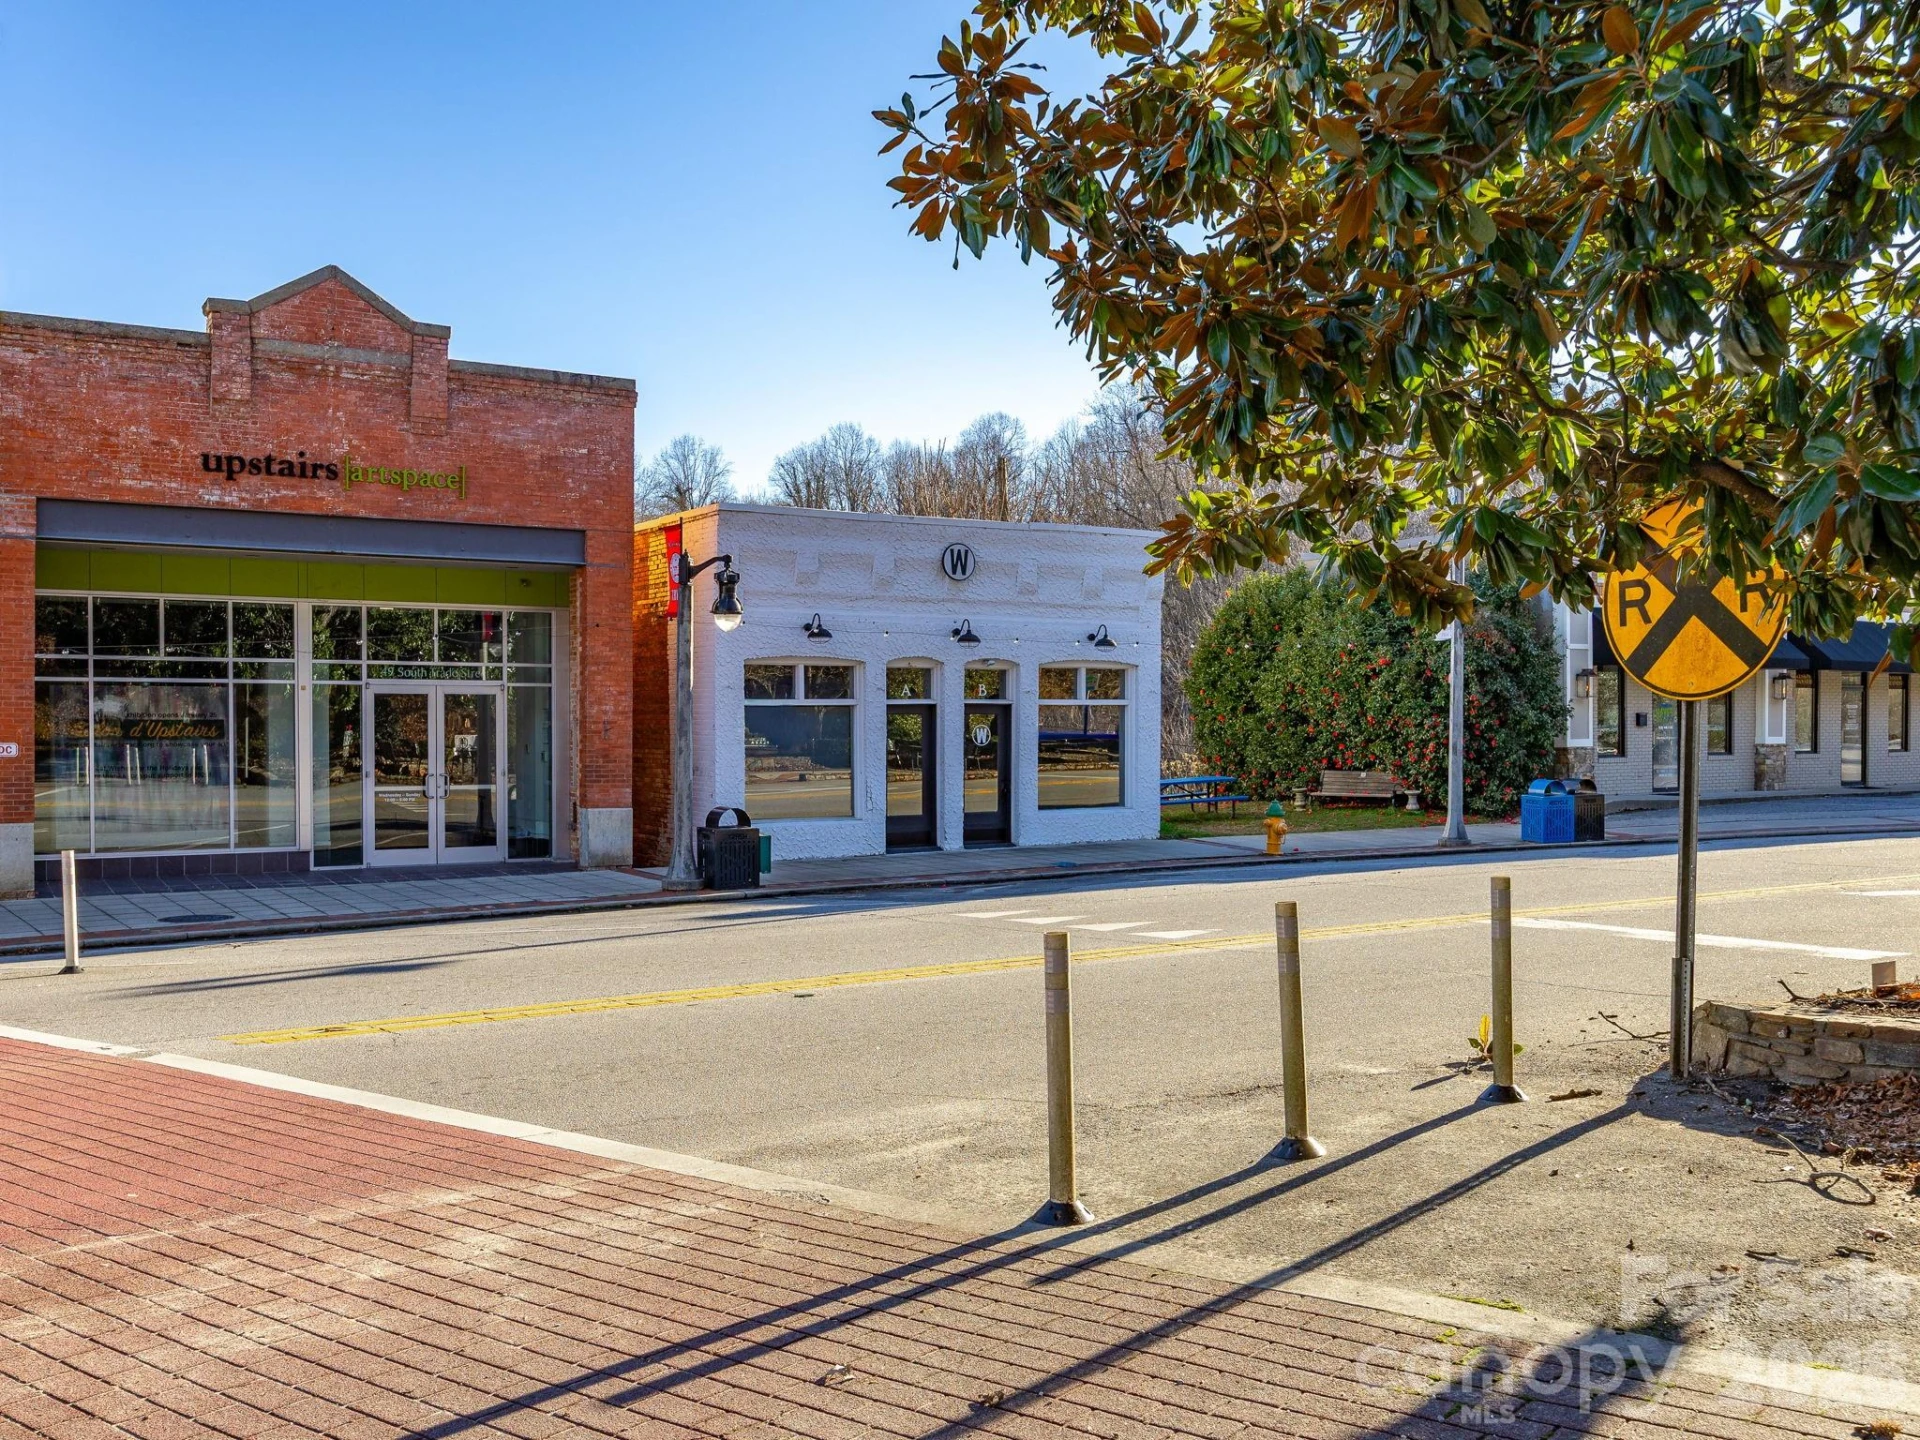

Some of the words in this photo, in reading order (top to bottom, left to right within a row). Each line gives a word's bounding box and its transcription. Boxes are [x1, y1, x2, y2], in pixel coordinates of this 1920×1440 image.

[201, 451, 339, 481] upstairs
[950, 549, 969, 576] W
[1618, 579, 1652, 627] R
[1739, 567, 1775, 613] R
[381, 665, 395, 677] 49
[398, 666, 427, 679] South
[901, 684, 912, 697] A
[978, 684, 988, 697] B
[975, 728, 988, 744] W
